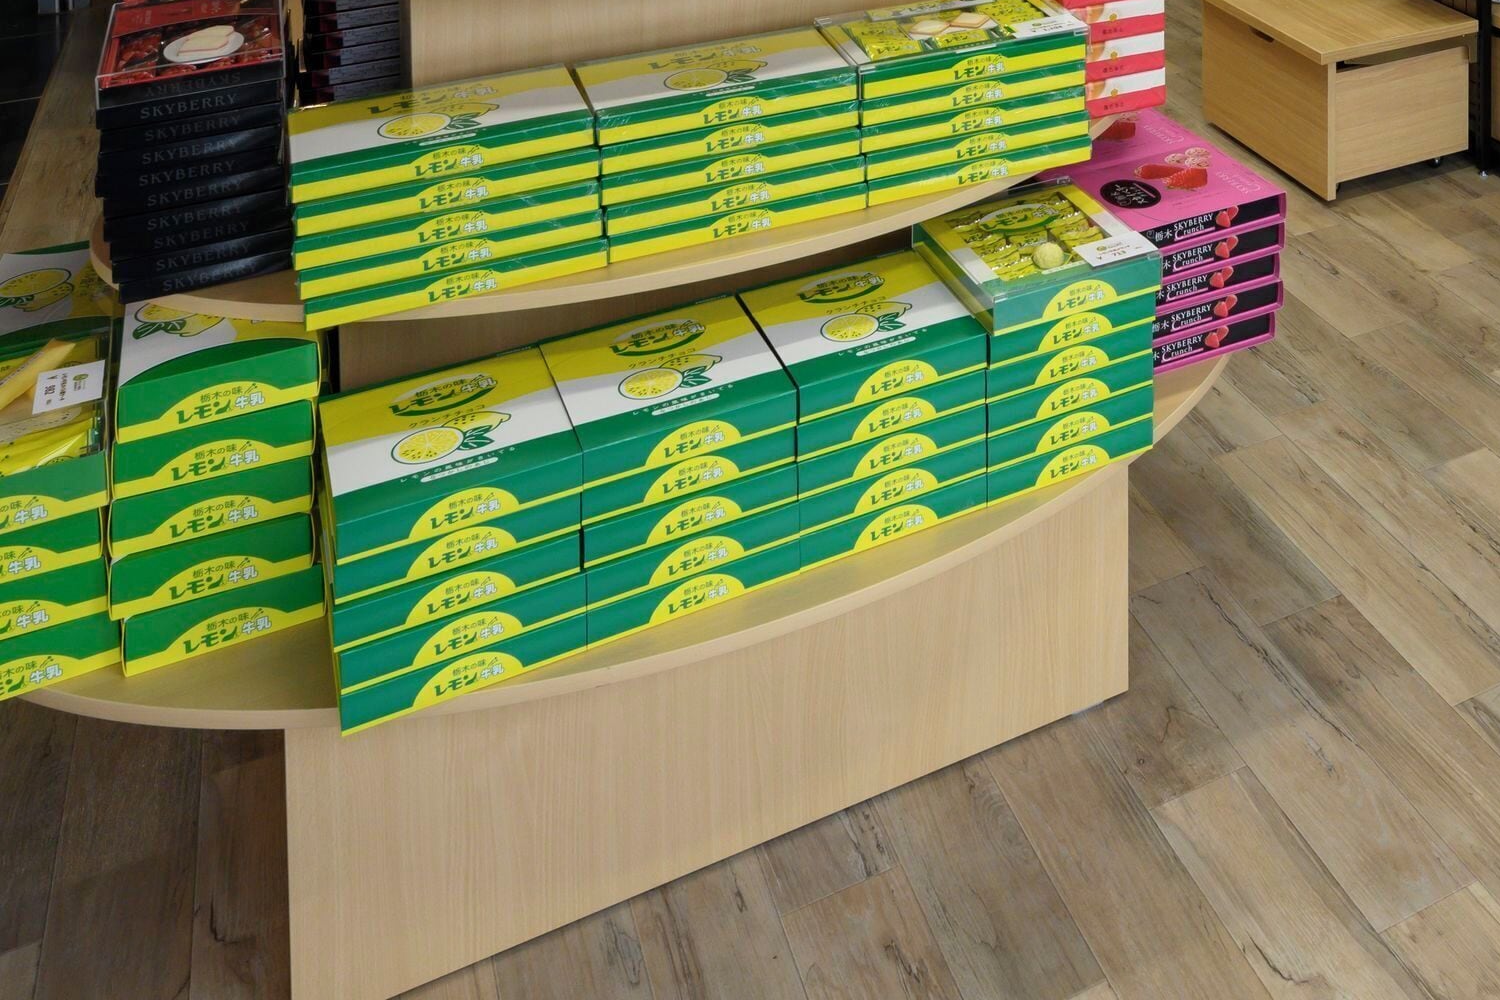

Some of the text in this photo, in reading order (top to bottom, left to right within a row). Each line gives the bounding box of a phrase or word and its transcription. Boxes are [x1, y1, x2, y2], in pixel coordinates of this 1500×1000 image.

[648, 45, 761, 70] レモン牛乳
[954, 63, 1005, 80] レモン牛乳
[140, 93, 239, 119] SKYBERRY
[367, 85, 498, 114] レモン牛乳
[952, 90, 1003, 107] レモン牛乳
[703, 105, 762, 124] レモン牛乳
[951, 116, 1002, 133] レモン牛乳
[145, 115, 240, 142] SKYBERRY
[142, 139, 237, 165] SKYBERRY
[706, 133, 765, 152] レモン牛乳
[956, 141, 1007, 159] レモン牛乳
[139, 160, 236, 187] SKYBERRY
[415, 154, 483, 177] レモン牛乳
[706, 162, 765, 183] レモン牛乳
[958, 167, 1008, 185] レモン牛乳
[148, 181, 242, 207] SKYBERRY
[419, 187, 488, 210] レモン牛乳
[711, 191, 771, 211] レモン牛乳
[148, 206, 242, 231] SKYBERRY
[713, 219, 772, 238] レモン牛乳
[980, 208, 1057, 229] レモン牛乳
[1174, 213, 1213, 230] SKYBERRY
[154, 221, 249, 249] SKYBERRY
[418, 221, 487, 242] レモン牛乳
[1155, 230, 1173, 241] 栃木
[1175, 224, 1205, 240] Crunch
[156, 242, 251, 272] SKYBERRY
[422, 249, 492, 271] レモン牛乳
[1173, 244, 1213, 261] SKYBERRY
[1173, 255, 1203, 271] Crunch
[428, 279, 496, 302] レモン牛乳
[799, 274, 884, 301] レモン牛乳
[1167, 275, 1208, 292] SKYBERRY
[1167, 285, 1198, 301] Crunch
[826, 296, 886, 314] クランチチョコ
[1057, 290, 1105, 311] レモン牛乳
[1171, 304, 1212, 321] SKYBERRY
[1172, 315, 1202, 331] Crunch
[610, 318, 707, 356] レモン牛乳
[1052, 323, 1101, 344] レモン牛乳
[1152, 321, 1169, 332] 栃木
[1162, 335, 1202, 353] SKYBERRY
[1162, 346, 1192, 362] Crunch
[628, 348, 696, 368] クランチチョコ
[1050, 358, 1097, 378] レモン牛乳
[414, 380, 467, 398] 栃木の味
[870, 371, 925, 395] レモン牛乳
[200, 387, 243, 402] 栃木の味
[389, 376, 498, 414] レモン牛乳
[1051, 391, 1098, 410] レモン牛乳
[177, 392, 265, 424] レモン牛乳
[408, 405, 485, 428] クランチチョコ
[868, 408, 923, 432] レモン牛乳
[664, 430, 725, 457] レモン牛乳
[1051, 423, 1098, 445] レモン牛乳
[195, 445, 237, 460] 栃木の味
[869, 444, 923, 469] レモン牛乳
[172, 450, 259, 481] レモン牛乳
[1050, 457, 1097, 478] レモン牛乳
[662, 466, 723, 494] レモン牛乳
[449, 495, 483, 510] 栃木の味
[870, 480, 925, 505] レモン牛乳
[193, 501, 235, 516] 栃木の味
[431, 499, 501, 530] レモン牛乳
[170, 505, 259, 538] レモン牛乳
[665, 507, 726, 534] レモン牛乳
[870, 516, 925, 541] レモン牛乳
[446, 533, 480, 550] 栃木の味
[428, 538, 499, 569] レモン牛乳
[668, 548, 728, 575] レモン牛乳
[192, 563, 235, 578] 栃木の味
[169, 567, 258, 600] レモン牛乳
[445, 577, 479, 595] 栃木の味
[427, 582, 497, 615] レモン牛乳
[668, 586, 728, 614] レモン牛乳
[206, 613, 249, 632] 栃木の味
[452, 620, 486, 636] 栃木の味
[183, 618, 271, 654] レモン牛乳
[434, 623, 504, 656] レモン牛乳
[452, 659, 486, 676] 栃木の味
[434, 664, 504, 696] レモン牛乳
